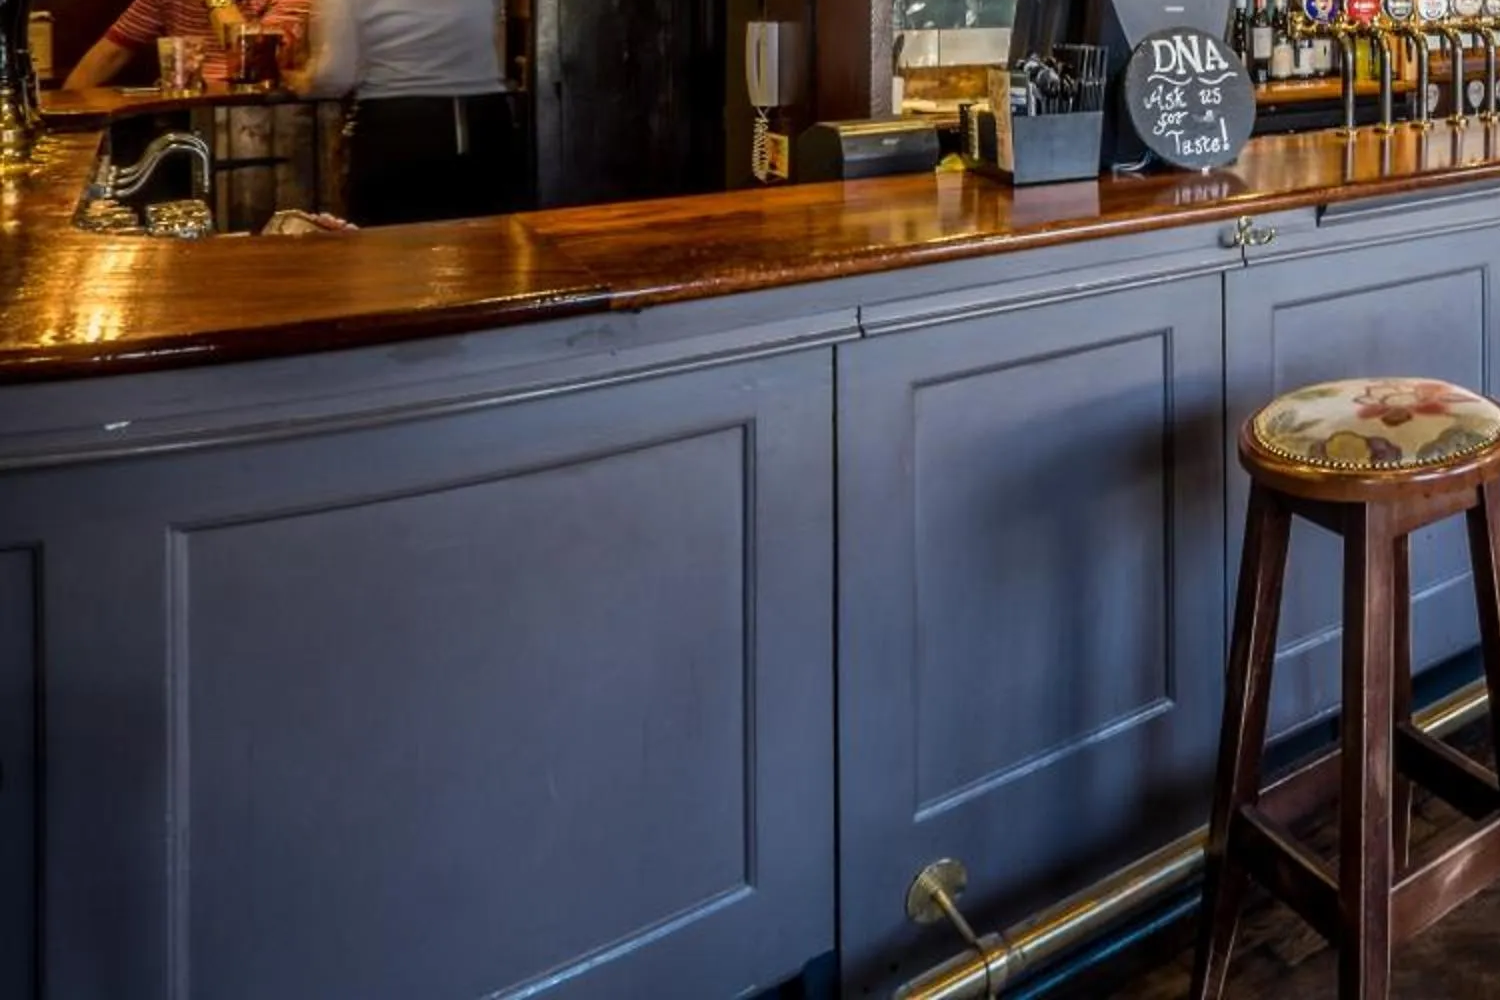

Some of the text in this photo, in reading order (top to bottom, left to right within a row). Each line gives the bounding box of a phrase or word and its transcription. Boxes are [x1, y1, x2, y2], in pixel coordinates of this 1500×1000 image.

[1151, 34, 1229, 75] DNA
[1143, 84, 1188, 111] Ask
[1152, 111, 1189, 136] for
[1165, 117, 1231, 156] Taste!
